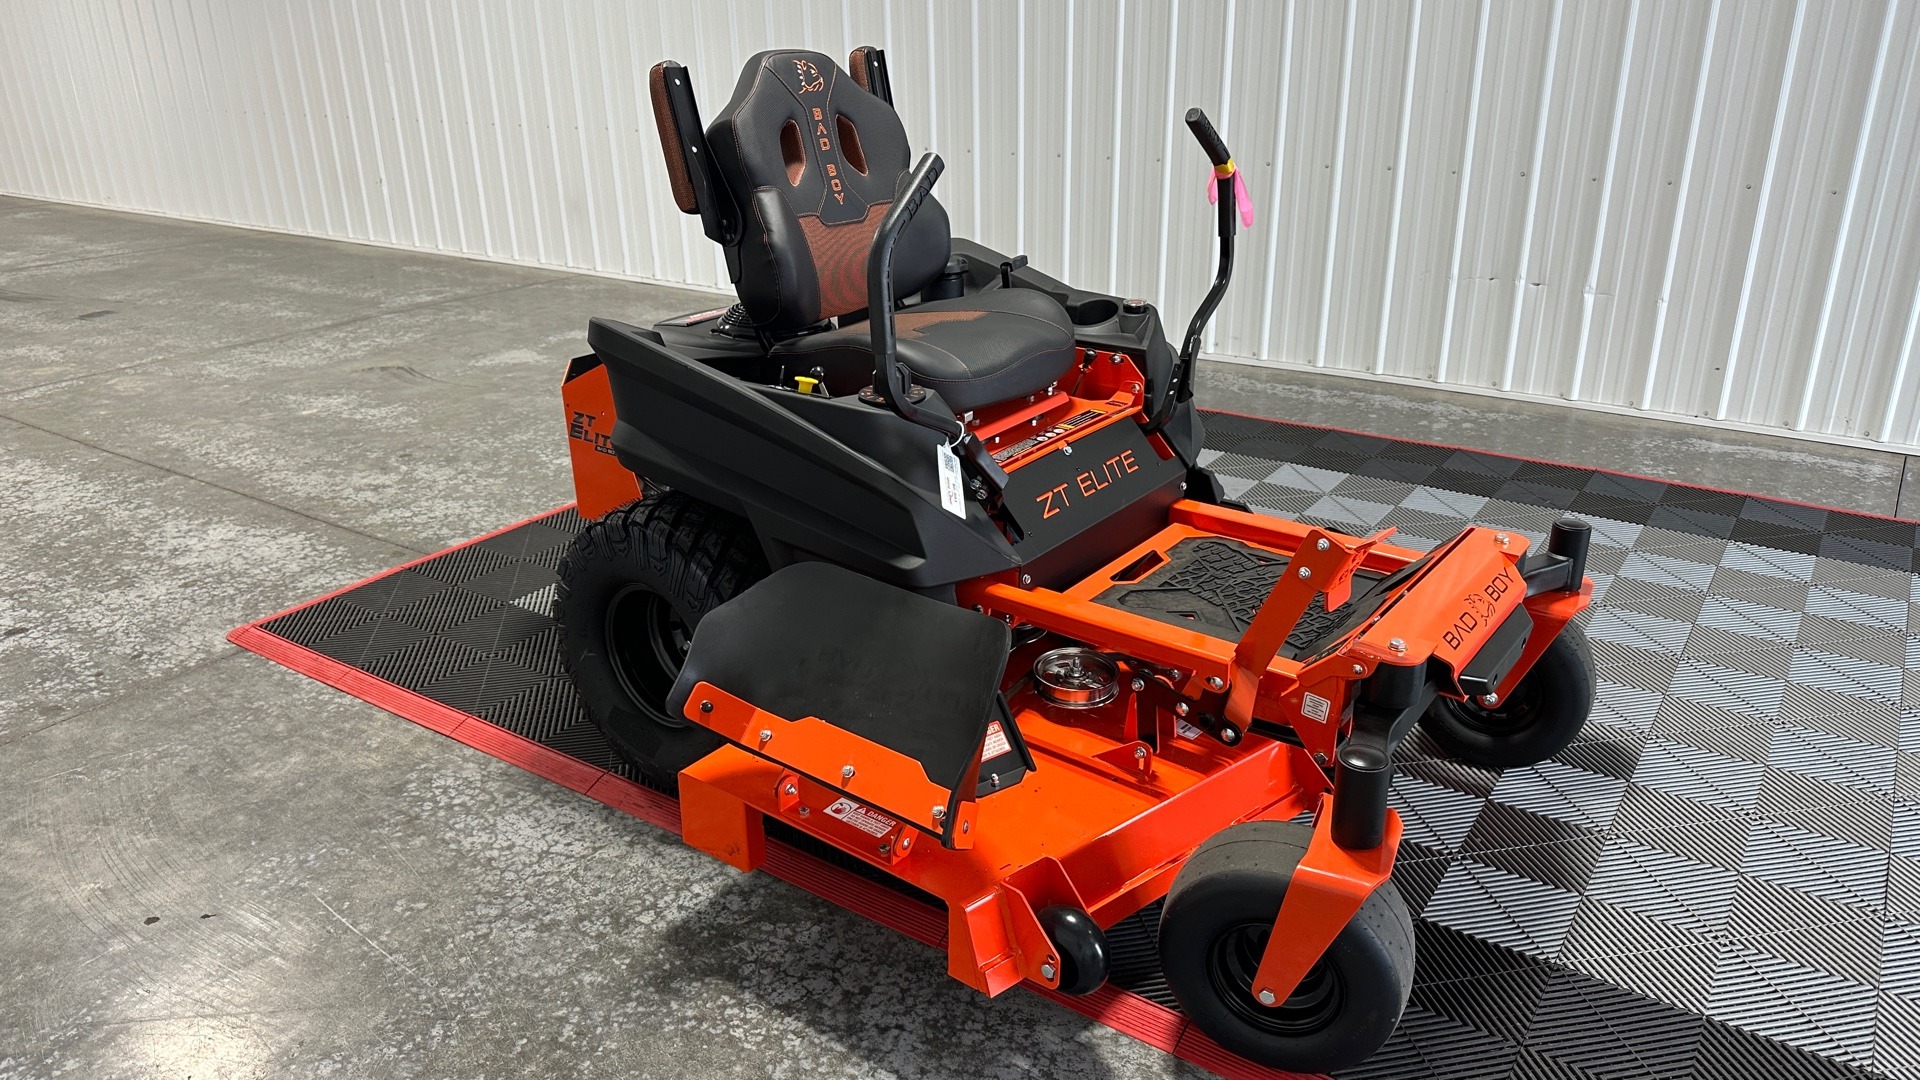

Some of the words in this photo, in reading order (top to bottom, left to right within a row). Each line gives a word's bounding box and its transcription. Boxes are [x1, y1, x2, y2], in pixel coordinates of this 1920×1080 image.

[812, 108, 830, 150] BAD
[827, 164, 844, 205] BOY
[570, 423, 613, 446] ELIT
[573, 411, 596, 427] ZT
[1035, 482, 1071, 520] ZT
[1076, 449, 1139, 498] ELITE
[1442, 611, 1478, 650] BAD
[1484, 567, 1514, 603] BOY
[867, 811, 896, 826] DANGER
